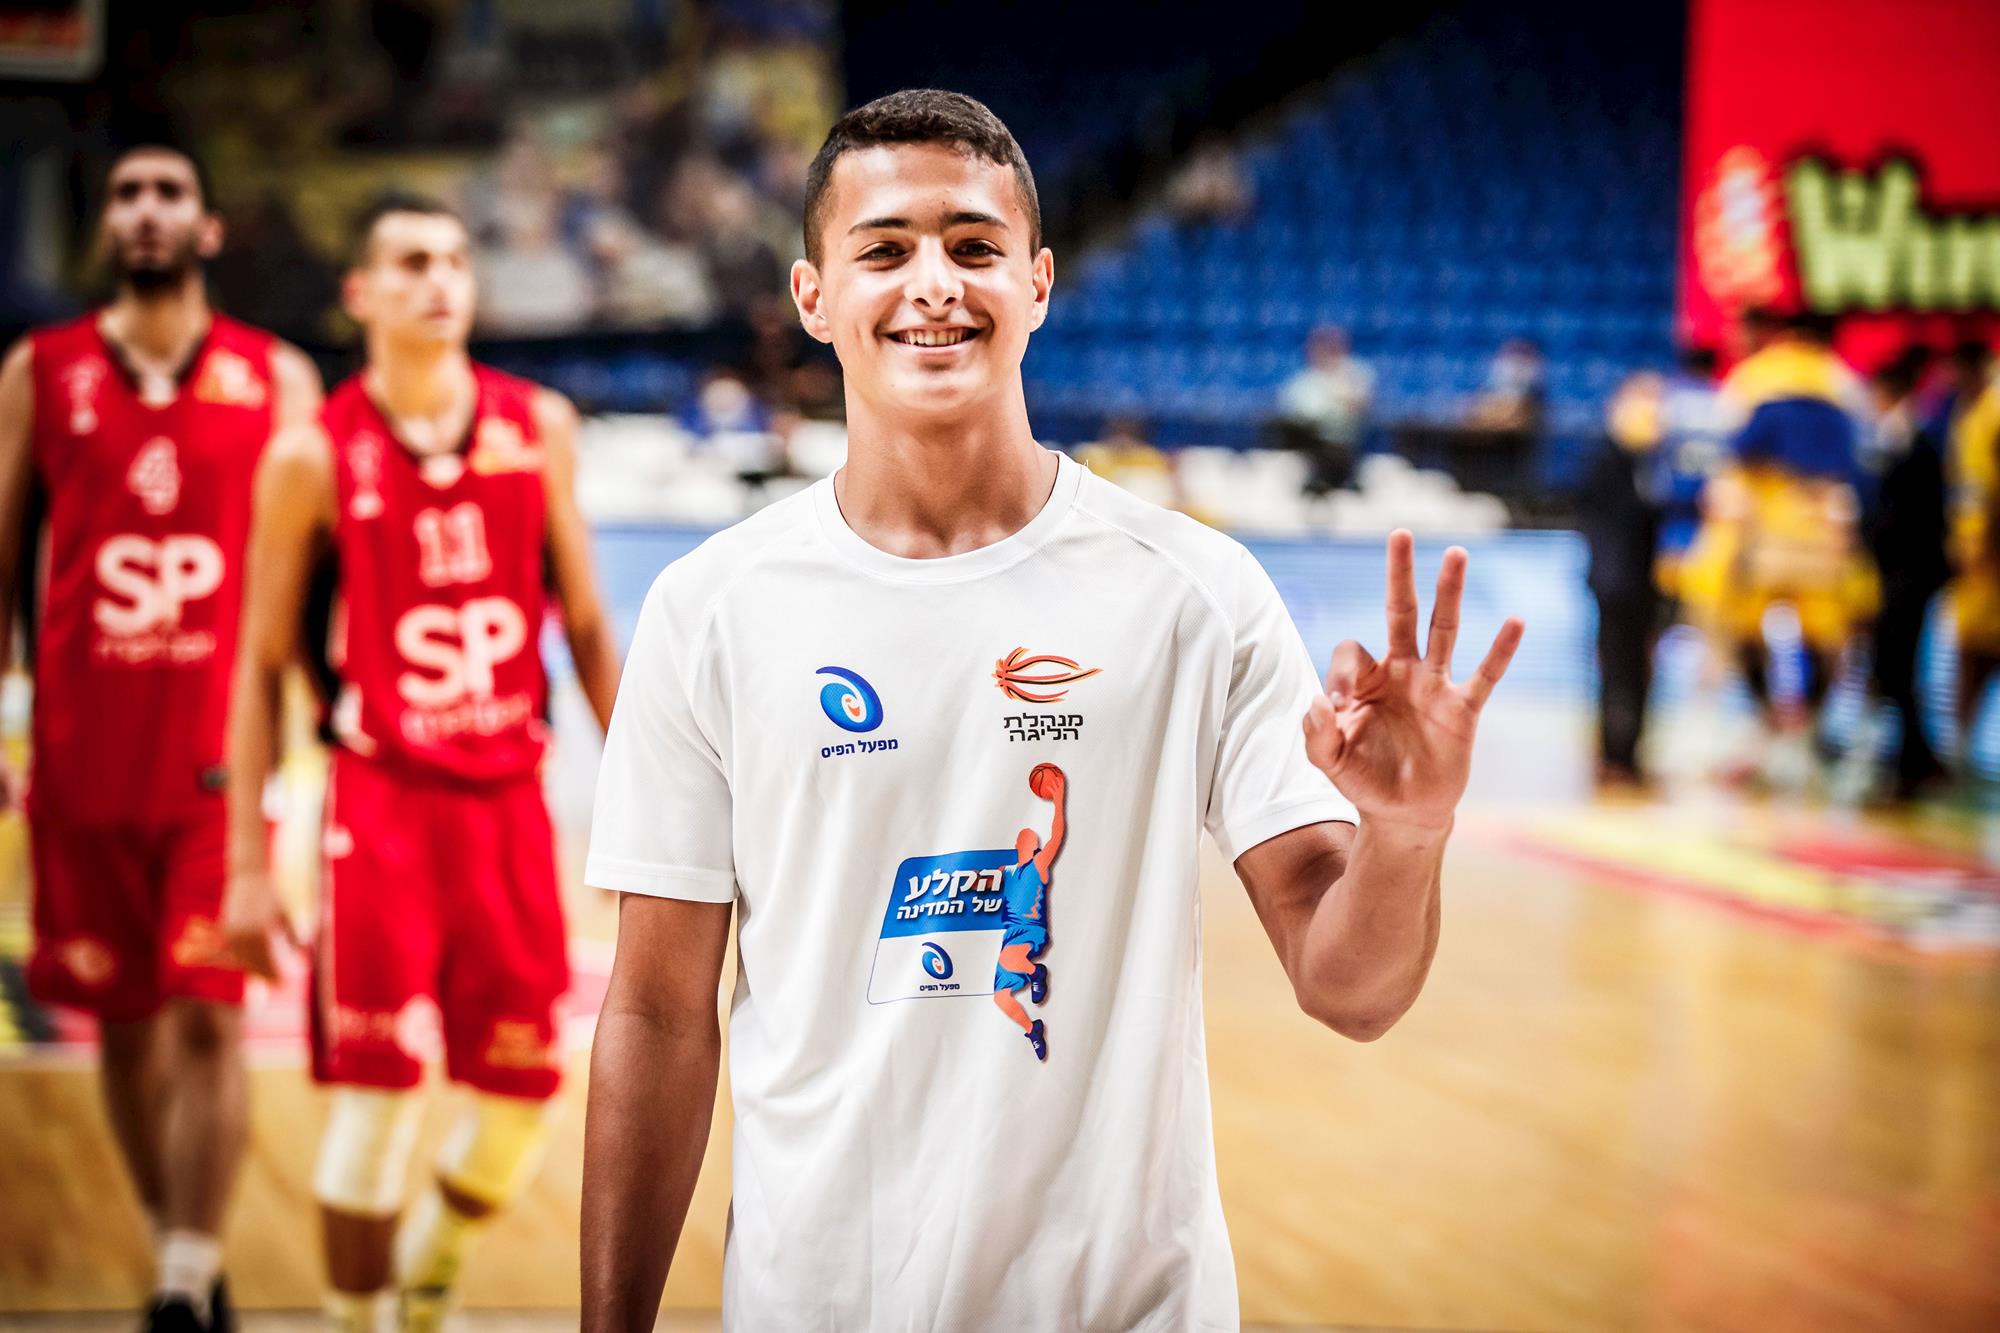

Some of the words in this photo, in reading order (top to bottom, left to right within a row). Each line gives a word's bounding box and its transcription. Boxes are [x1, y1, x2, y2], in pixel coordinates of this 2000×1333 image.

[127, 435, 181, 515] 4
[414, 501, 492, 588] 11
[94, 533, 226, 635] SP
[394, 595, 528, 708] SP
[1003, 712, 1084, 729] מנהלת
[1009, 725, 1079, 742] הליגה
[821, 743, 855, 759] הפיס
[857, 738, 899, 754] מפעל
[904, 868, 1003, 903] הקלע
[896, 900, 965, 920] המדינה
[972, 896, 1003, 913] של
[939, 983, 960, 991] מפעל
